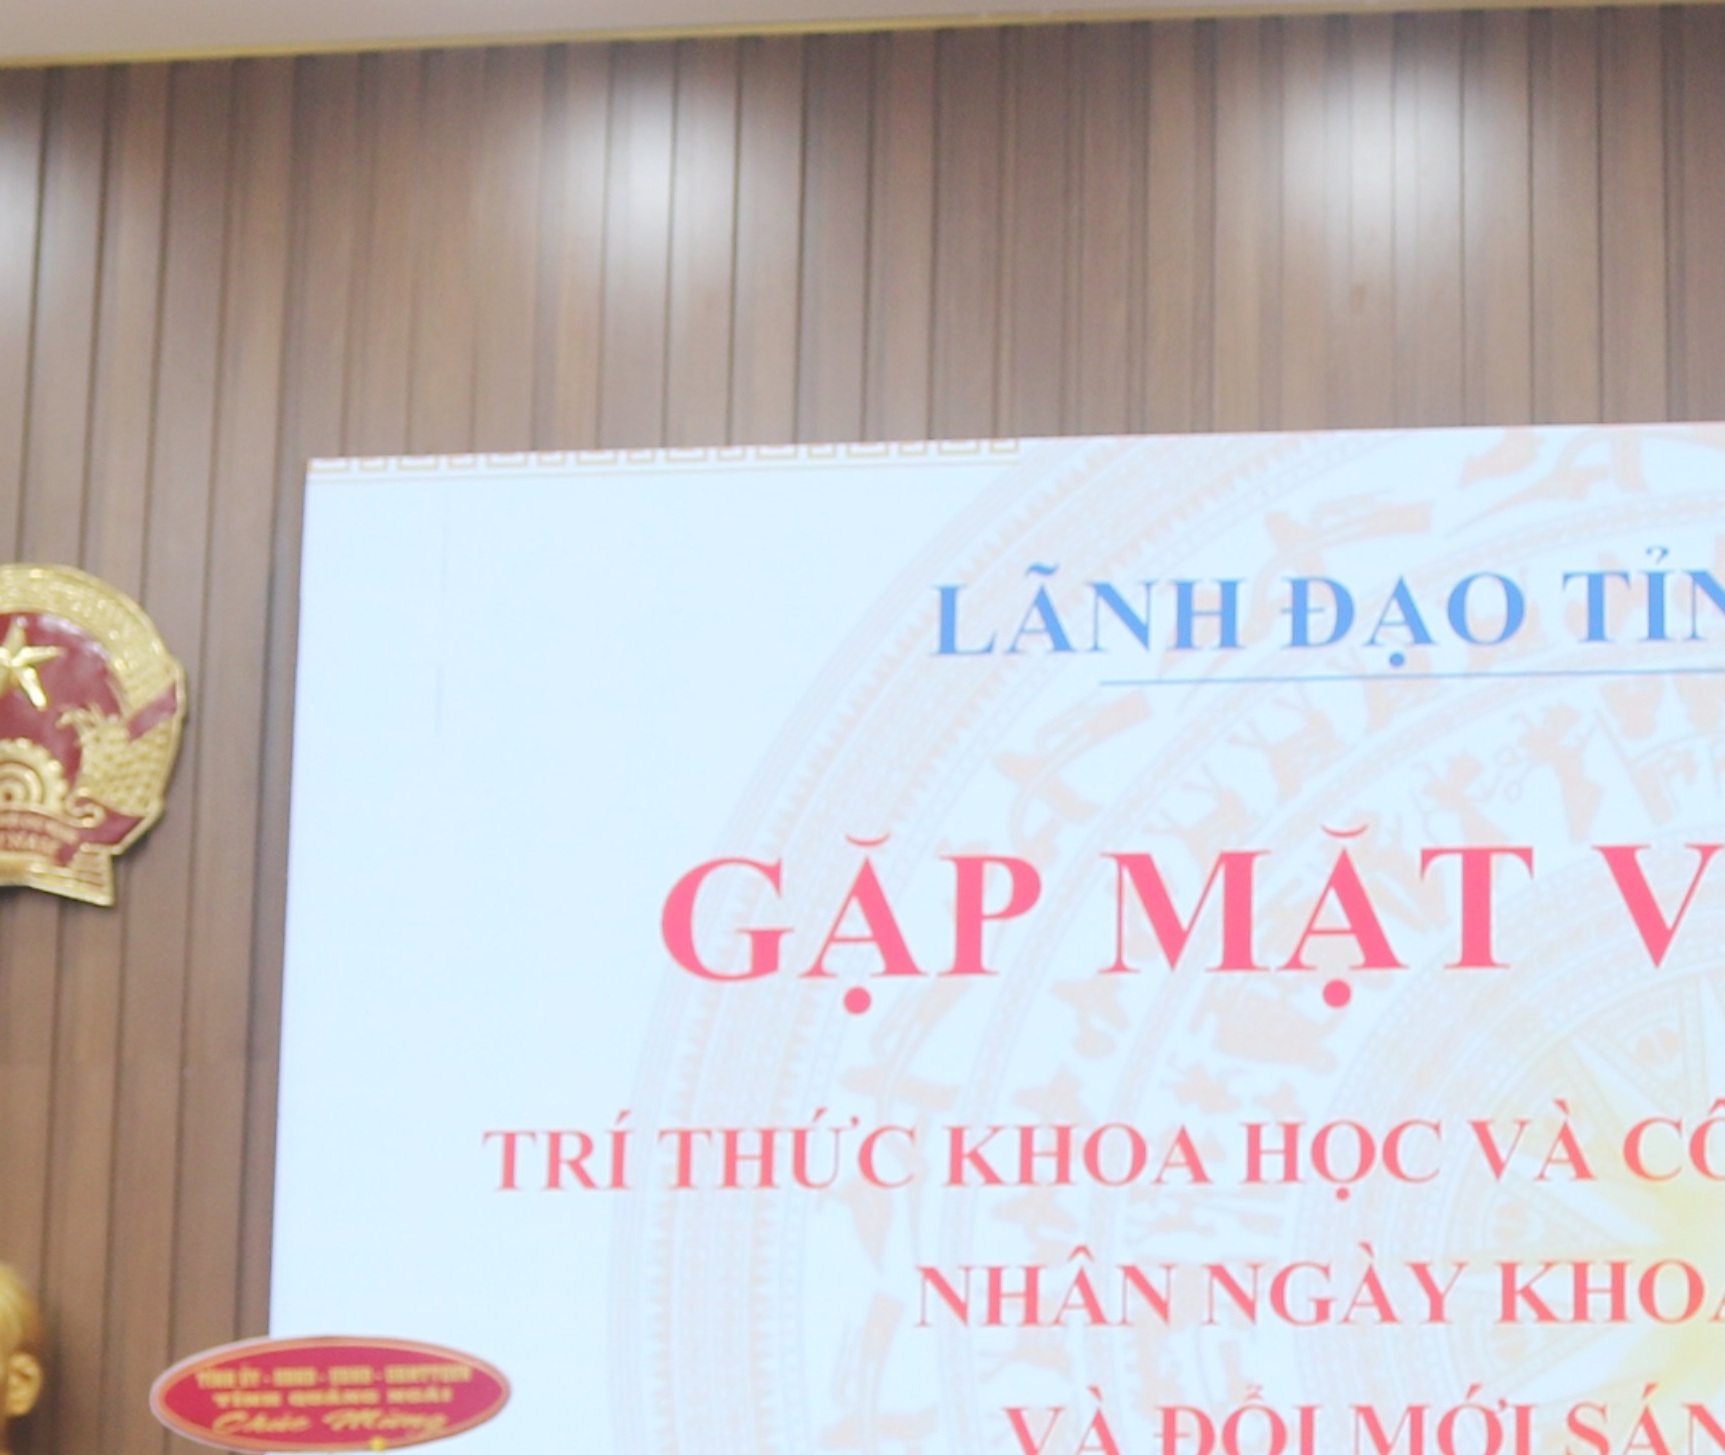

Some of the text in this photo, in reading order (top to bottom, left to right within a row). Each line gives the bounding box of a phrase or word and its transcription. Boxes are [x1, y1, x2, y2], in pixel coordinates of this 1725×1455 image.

[930, 562, 1247, 657] LÃNH
[1282, 571, 1526, 668] ĐẠO
[660, 830, 1043, 1014] GẶP
[1101, 822, 1534, 1008] MẶT
[483, 1110, 632, 1192] TRÍ
[658, 1106, 916, 1190] THỨC
[946, 1123, 1214, 1187] KHOA
[1240, 1119, 1442, 1200] HỌC
[1466, 1098, 1598, 1182] VÀ
[917, 1244, 1173, 1327] NHÂN
[1202, 1241, 1468, 1325] NGÀY
